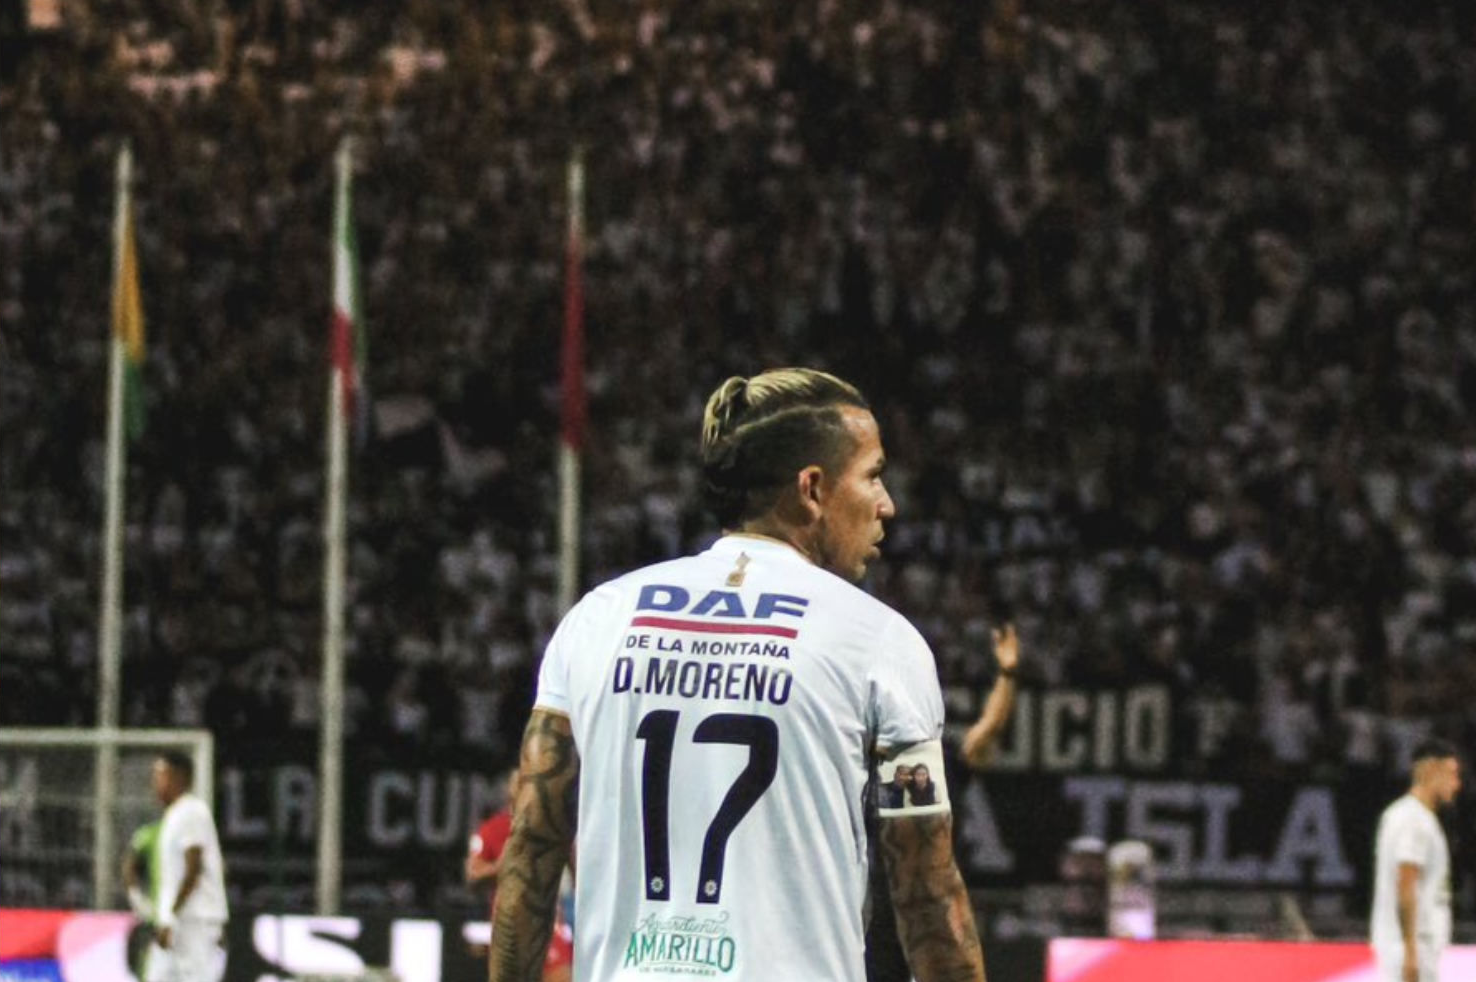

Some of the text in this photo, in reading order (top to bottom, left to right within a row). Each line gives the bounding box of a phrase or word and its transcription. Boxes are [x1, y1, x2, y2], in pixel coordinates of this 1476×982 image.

[636, 584, 809, 619] DAF
[626, 634, 791, 660] DE LA MONTAÑA
[612, 656, 794, 706] D.MORENO
[635, 709, 780, 904] 17
[624, 932, 736, 973] AMARILLO
